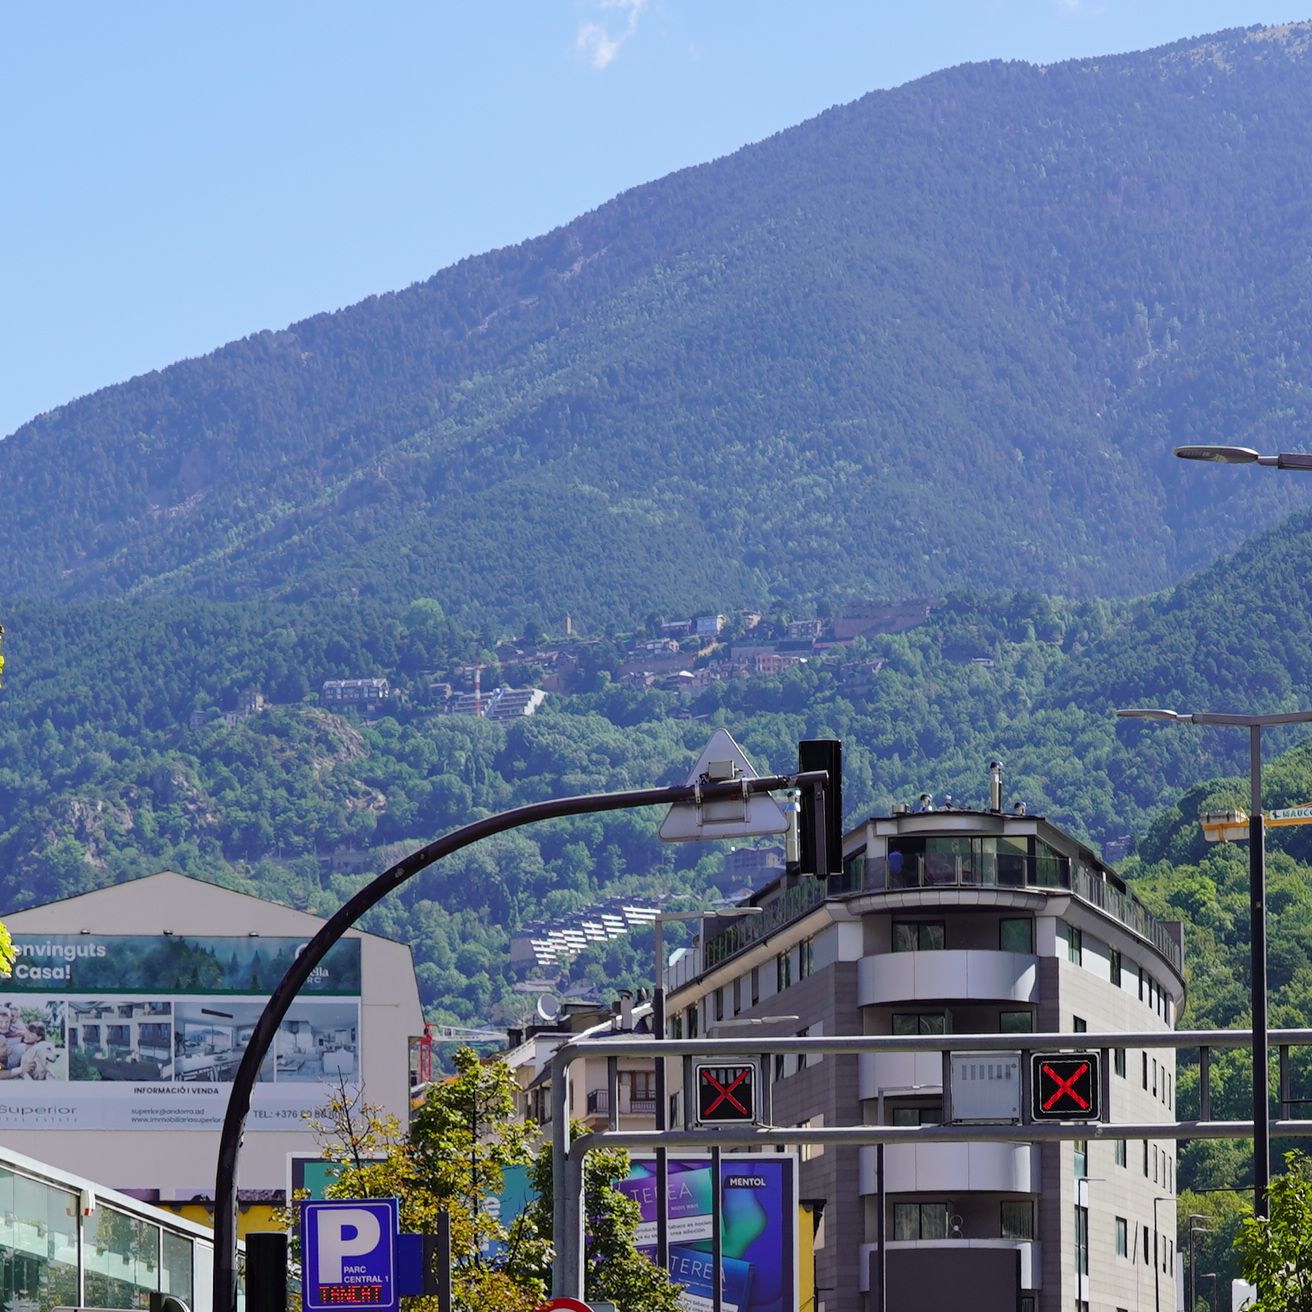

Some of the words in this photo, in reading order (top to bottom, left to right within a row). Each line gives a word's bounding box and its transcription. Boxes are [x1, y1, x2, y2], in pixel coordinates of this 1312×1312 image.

[13, 941, 106, 961] envinguts
[15, 964, 71, 980] Casa!
[192, 1087, 219, 1095] VENDA
[729, 1177, 766, 1187] MENTOL
[317, 1209, 381, 1284] P
[344, 1265, 366, 1274] PARC
[344, 1275, 382, 1284] CENTRAL
[319, 1285, 382, 1303] TANCAT
